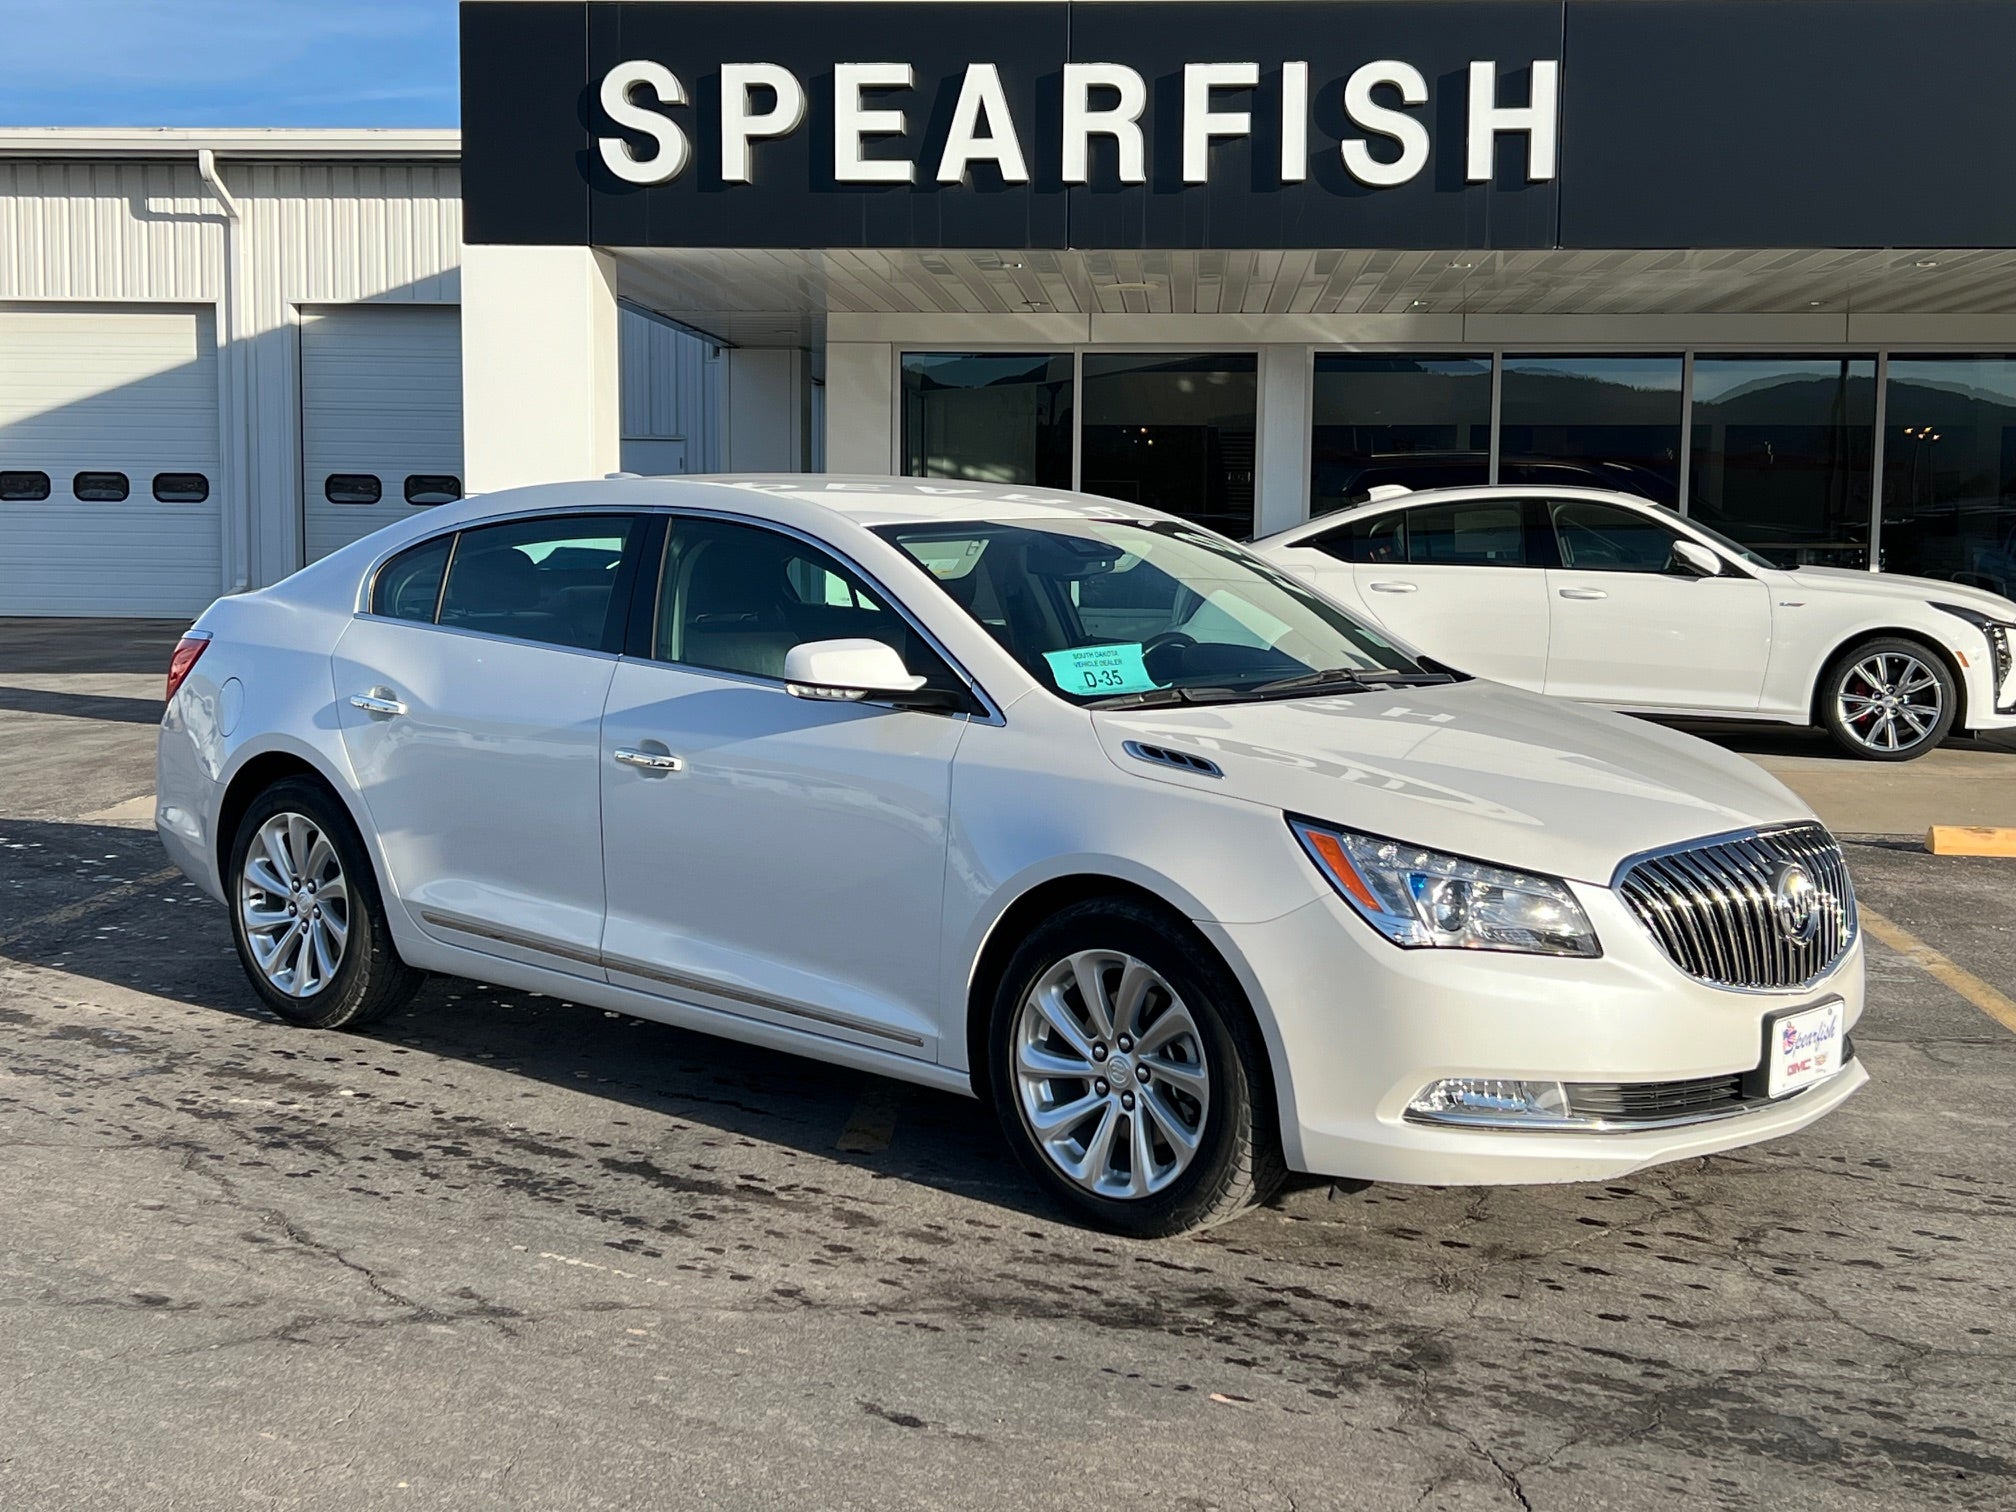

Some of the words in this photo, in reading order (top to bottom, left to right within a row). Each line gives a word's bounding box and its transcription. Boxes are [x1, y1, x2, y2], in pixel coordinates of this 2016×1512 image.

[597, 60, 1558, 186] SPEARFISH
[1072, 652, 1094, 660] SOUTH
[1095, 650, 1118, 658] DAKOTA
[1073, 660, 1099, 668] VEHICLE
[1099, 658, 1122, 667] DEALER
[1083, 670, 1123, 687] D-35
[1786, 1058, 1811, 1077] GMC
